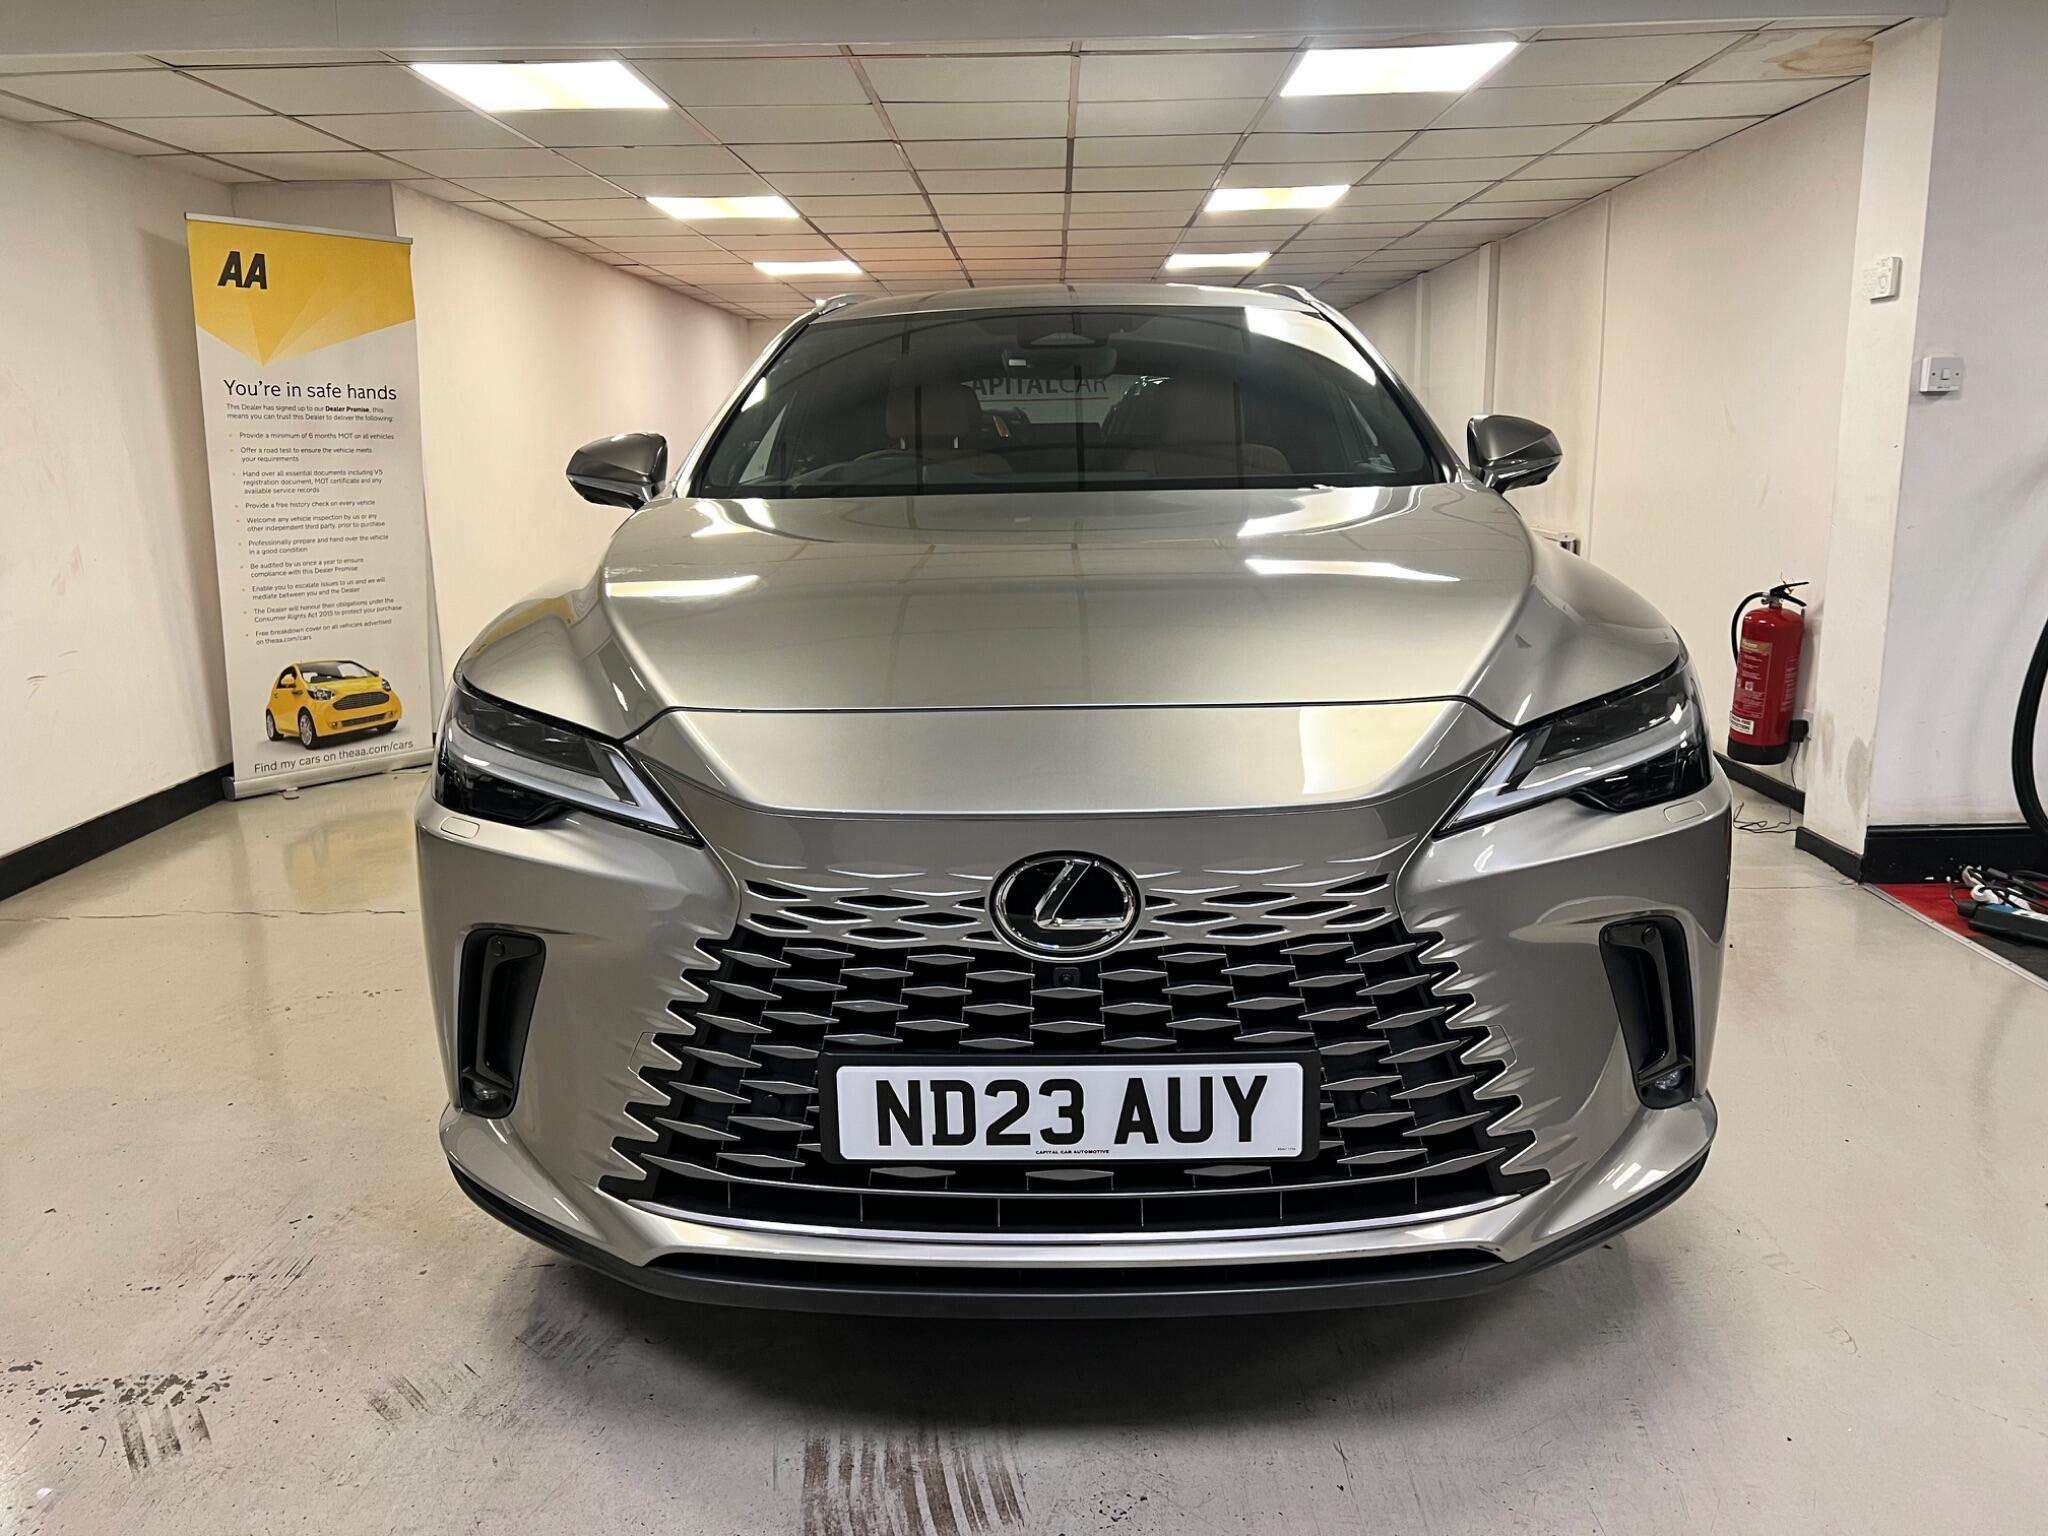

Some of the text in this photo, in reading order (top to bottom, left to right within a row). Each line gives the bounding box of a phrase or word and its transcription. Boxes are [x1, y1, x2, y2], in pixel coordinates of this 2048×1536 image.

[217, 250, 268, 290] AA
[224, 379, 397, 400] You’re in safe hands
[227, 403, 240, 411] This
[263, 404, 275, 412] has
[276, 404, 297, 413] signed
[325, 405, 345, 413] Dealer
[250, 413, 262, 421] you
[305, 413, 325, 421] Dealer
[334, 414, 355, 422] deliver
[240, 431, 264, 439] Provide
[314, 432, 338, 440] months
[338, 432, 353, 440] MOT
[241, 446, 258, 454] Offer
[264, 446, 279, 454] road
[280, 446, 292, 454] test
[242, 456, 256, 464] your
[347, 468, 374, 477] including
[374, 468, 384, 476] V5
[243, 479, 280, 487] registration
[314, 477, 329, 485] MOT
[330, 477, 360, 485] certificate
[245, 501, 270, 509] Provide
[289, 501, 311, 509] history
[311, 500, 330, 508] check
[312, 514, 343, 522] inspection
[265, 524, 304, 532] independent
[248, 539, 292, 547] Professionally
[292, 538, 317, 546] prepare
[279, 546, 308, 554] condition
[260, 561, 284, 569] audited
[323, 559, 336, 567] year
[250, 570, 287, 579] compliance
[252, 584, 274, 593] Enable
[274, 584, 287, 592] you
[295, 582, 320, 590] escalate
[320, 580, 339, 588] issues
[252, 593, 278, 601] mediate
[278, 591, 306, 599] between
[306, 590, 318, 598] you
[340, 586, 361, 594] Dealer
[253, 607, 266, 615] The
[266, 606, 288, 614] Dealer
[335, 600, 368, 608] obligations
[254, 614, 287, 623] Consumer
[287, 613, 307, 621] Rights
[319, 610, 334, 618] 2015
[341, 608, 363, 616] protect
[376, 605, 402, 613] purchase
[270, 628, 304, 636] breakdown
[364, 619, 392, 627] advertised
[254, 740, 414, 773] Find my cars on theaa.com/cars
[875, 1075, 1268, 1147] ND23 AUY
